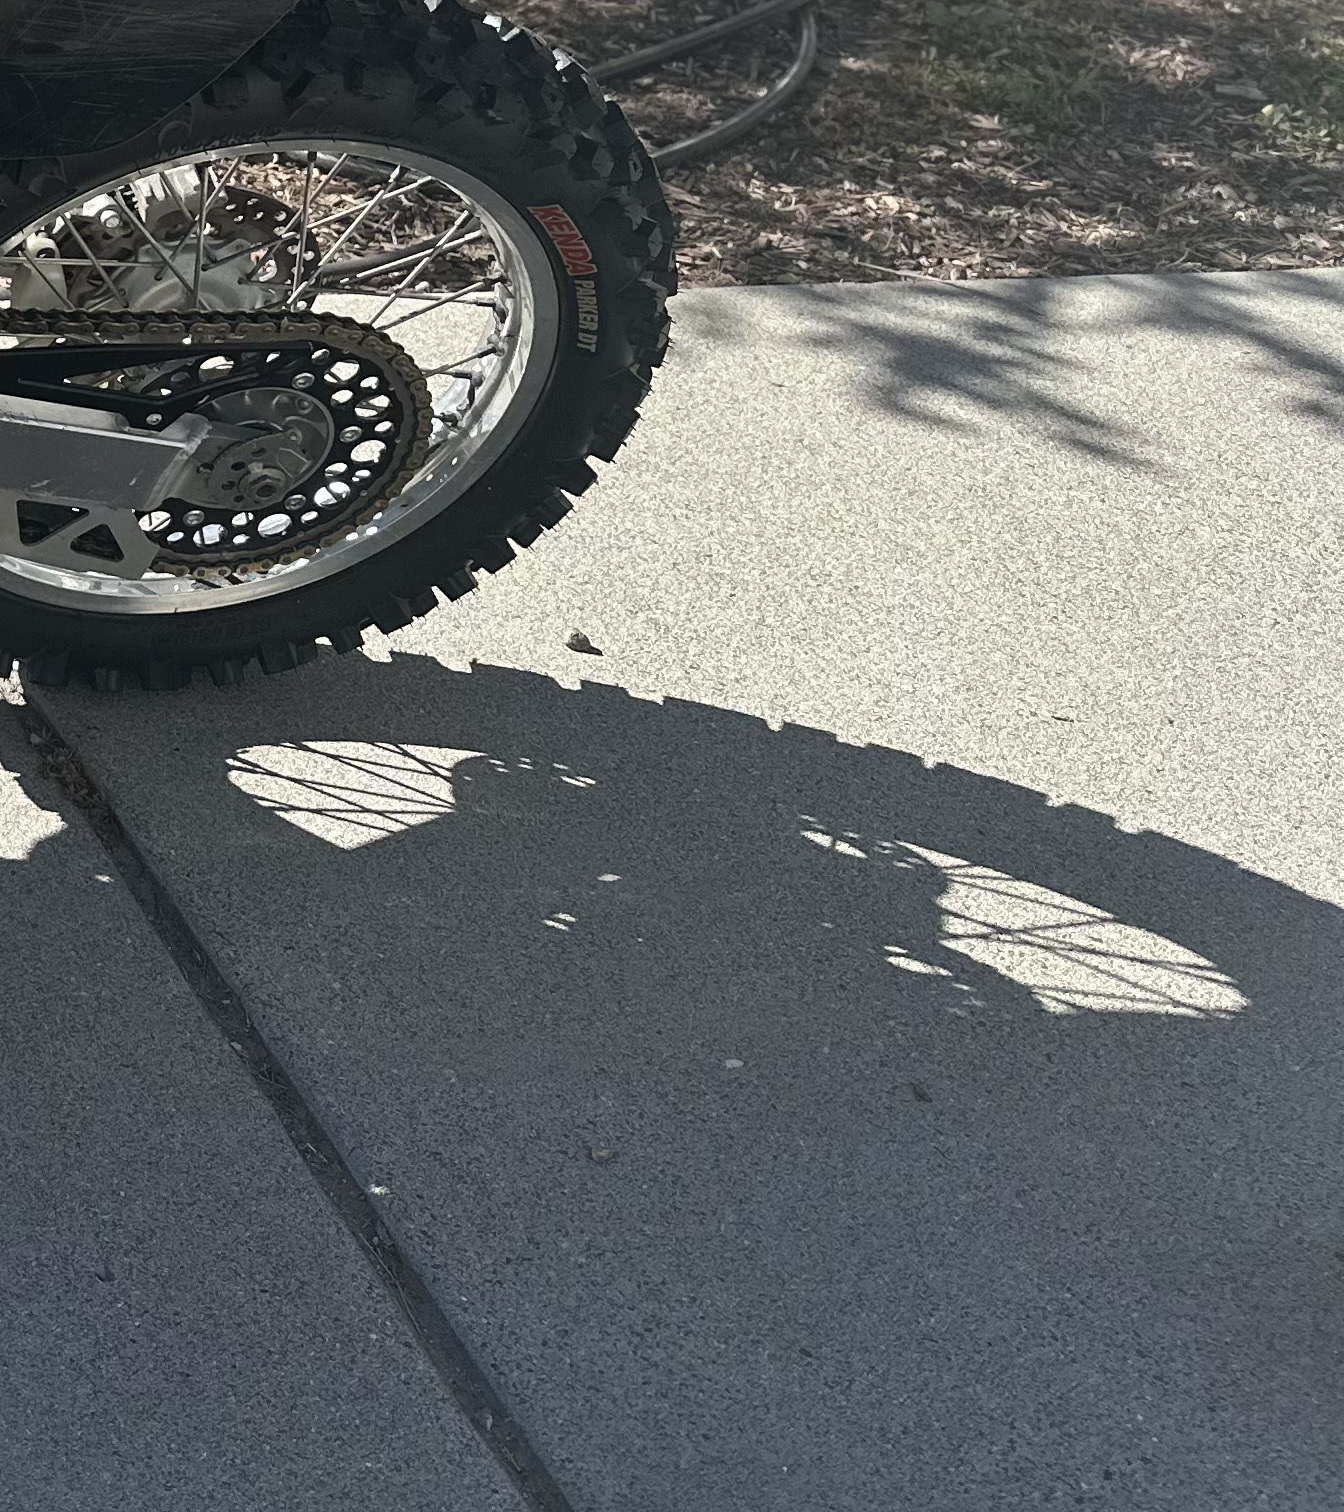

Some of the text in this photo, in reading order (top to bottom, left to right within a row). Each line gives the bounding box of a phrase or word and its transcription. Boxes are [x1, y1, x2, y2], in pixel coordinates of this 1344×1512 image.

[528, 204, 599, 353] KENDA PARKER DT
